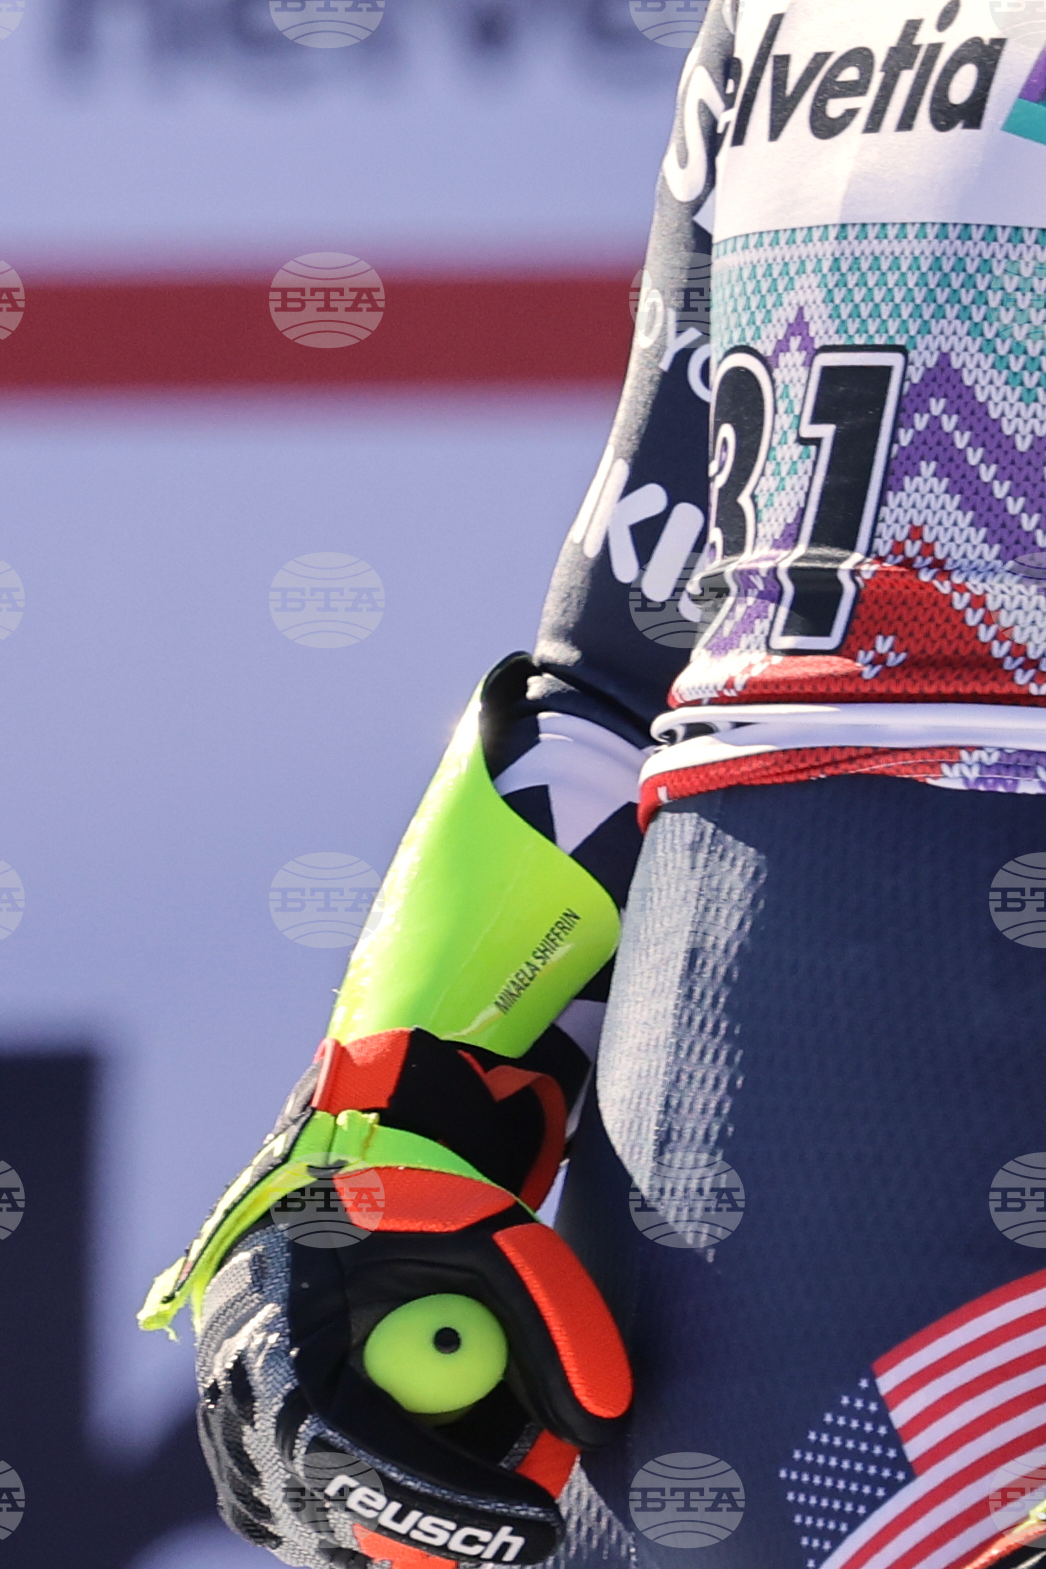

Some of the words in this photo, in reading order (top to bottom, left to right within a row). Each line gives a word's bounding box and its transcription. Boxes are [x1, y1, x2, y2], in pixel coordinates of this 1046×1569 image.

[706, 334, 908, 653] 31
[493, 961, 541, 1016] MIKAELA
[531, 908, 582, 966] SHIFFRIN
[323, 1474, 526, 1562] reusch
